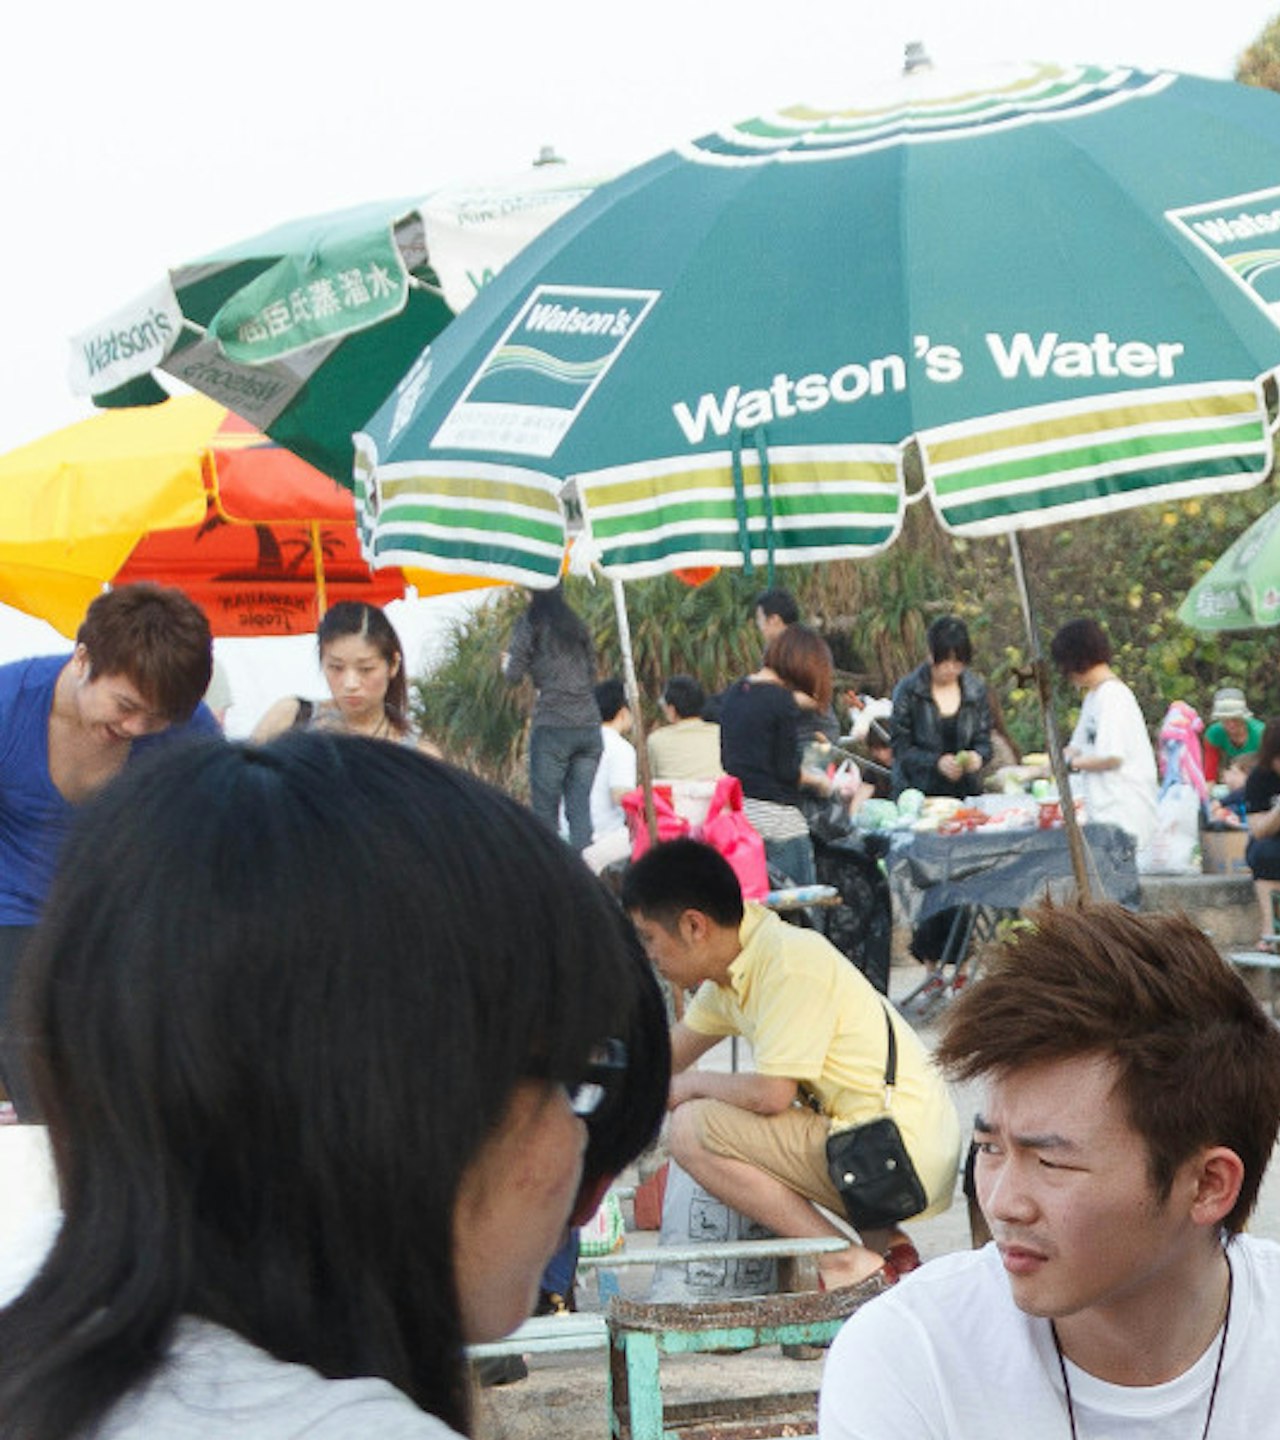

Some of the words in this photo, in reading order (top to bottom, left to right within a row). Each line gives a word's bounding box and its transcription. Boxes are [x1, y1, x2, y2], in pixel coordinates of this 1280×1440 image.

[84, 308, 172, 376] Watson's
[525, 302, 631, 336] Watson's
[673, 335, 963, 444] Watson's
[986, 333, 1184, 378] Water
